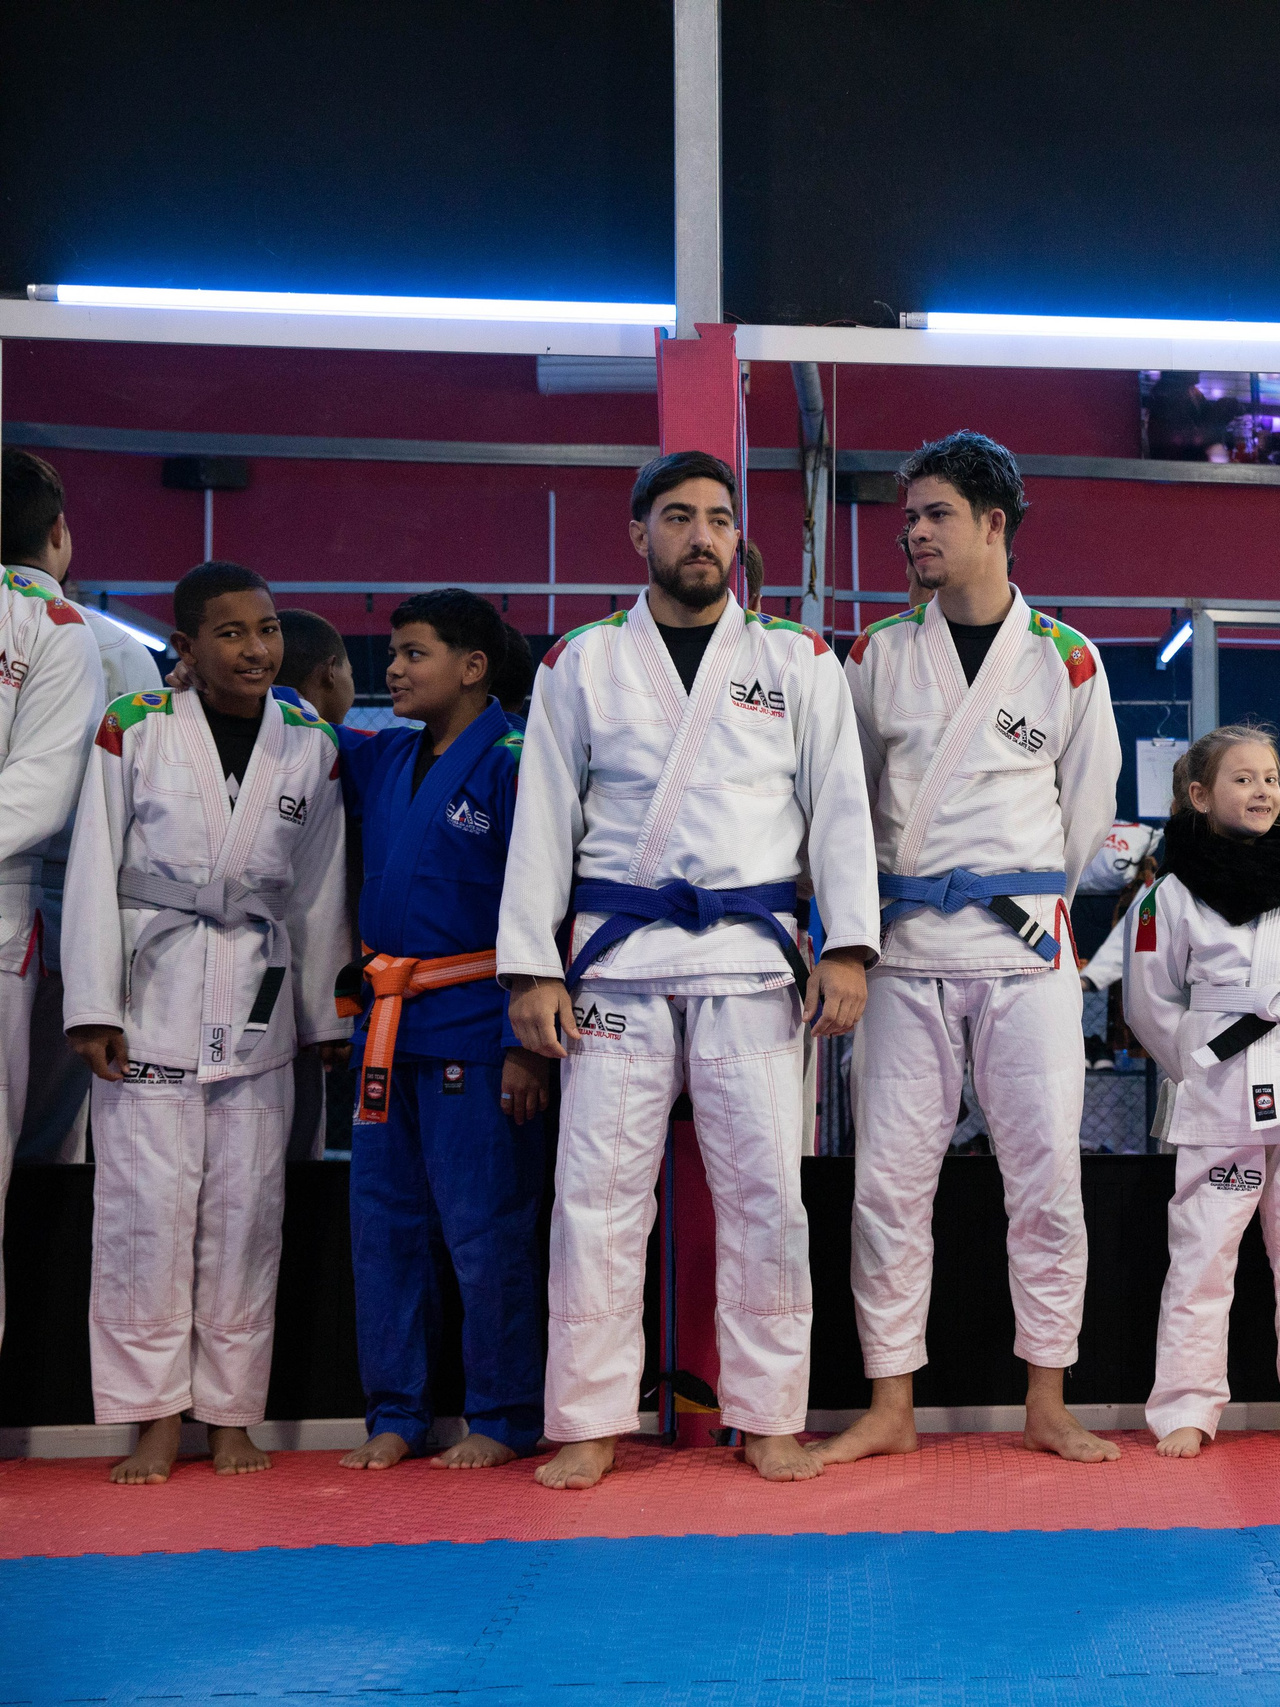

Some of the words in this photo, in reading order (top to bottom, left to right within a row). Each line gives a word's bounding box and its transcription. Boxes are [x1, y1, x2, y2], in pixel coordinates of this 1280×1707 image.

[729, 678, 785, 711] GAS
[996, 708, 1046, 750] GAS
[279, 795, 307, 820] GA
[445, 799, 490, 830] GAS
[208, 1027, 224, 1063] GAS
[1209, 1162, 1262, 1186] GAS
